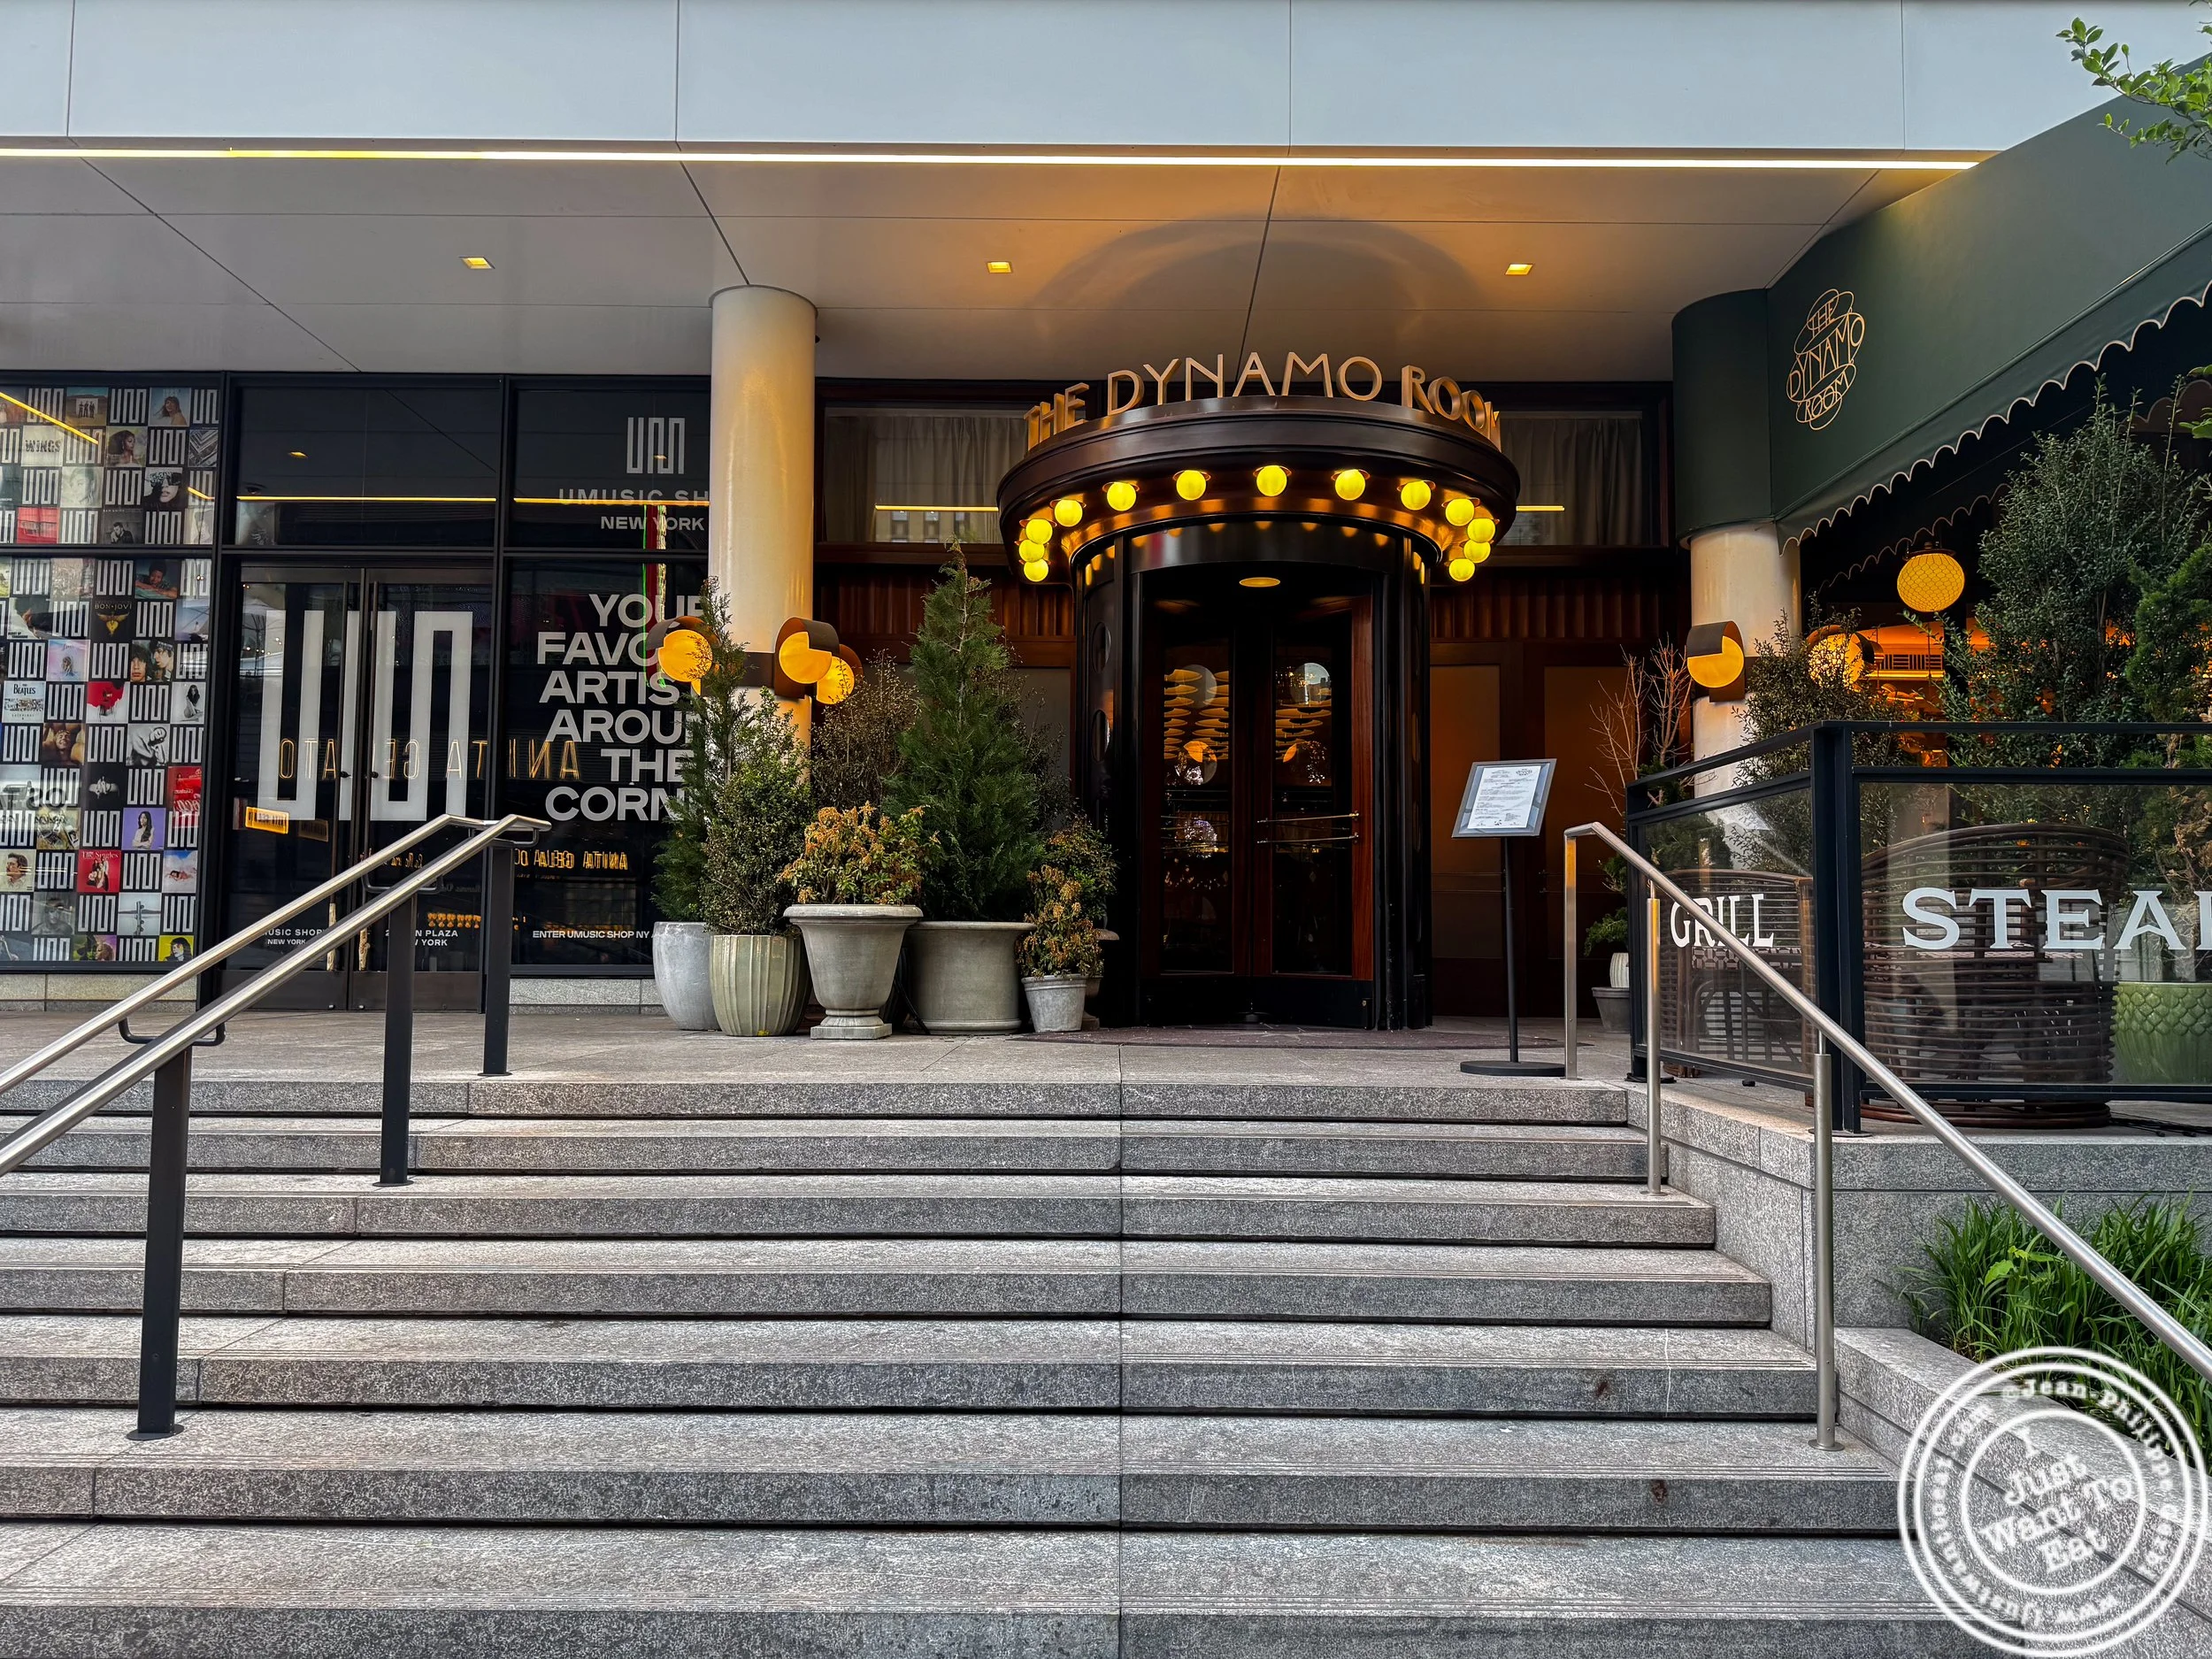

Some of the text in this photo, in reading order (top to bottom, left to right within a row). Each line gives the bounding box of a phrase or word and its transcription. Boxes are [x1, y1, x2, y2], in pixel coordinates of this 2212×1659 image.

[1807, 299, 1836, 338] THE
[1788, 313, 1865, 399] DYNAMO
[1024, 382, 1089, 451] THE
[1108, 351, 1383, 416] DYNAMO
[1804, 371, 1850, 422] ROOM
[25, 440, 62, 453] WINGS
[559, 488, 709, 506] UMUSIC SH
[601, 516, 705, 532] NEW YORK
[537, 632, 659, 666] FAVO
[13, 684, 35, 696] BEATLES
[539, 670, 693, 705] ARTIS
[601, 749, 695, 782] THE
[545, 787, 687, 821] CORN
[532, 930, 566, 939] ENTER
[566, 930, 605, 939] UMUSIC
[606, 930, 634, 939] SHOP
[635, 930, 650, 939] NY
[1671, 893, 1775, 949] GRILL
